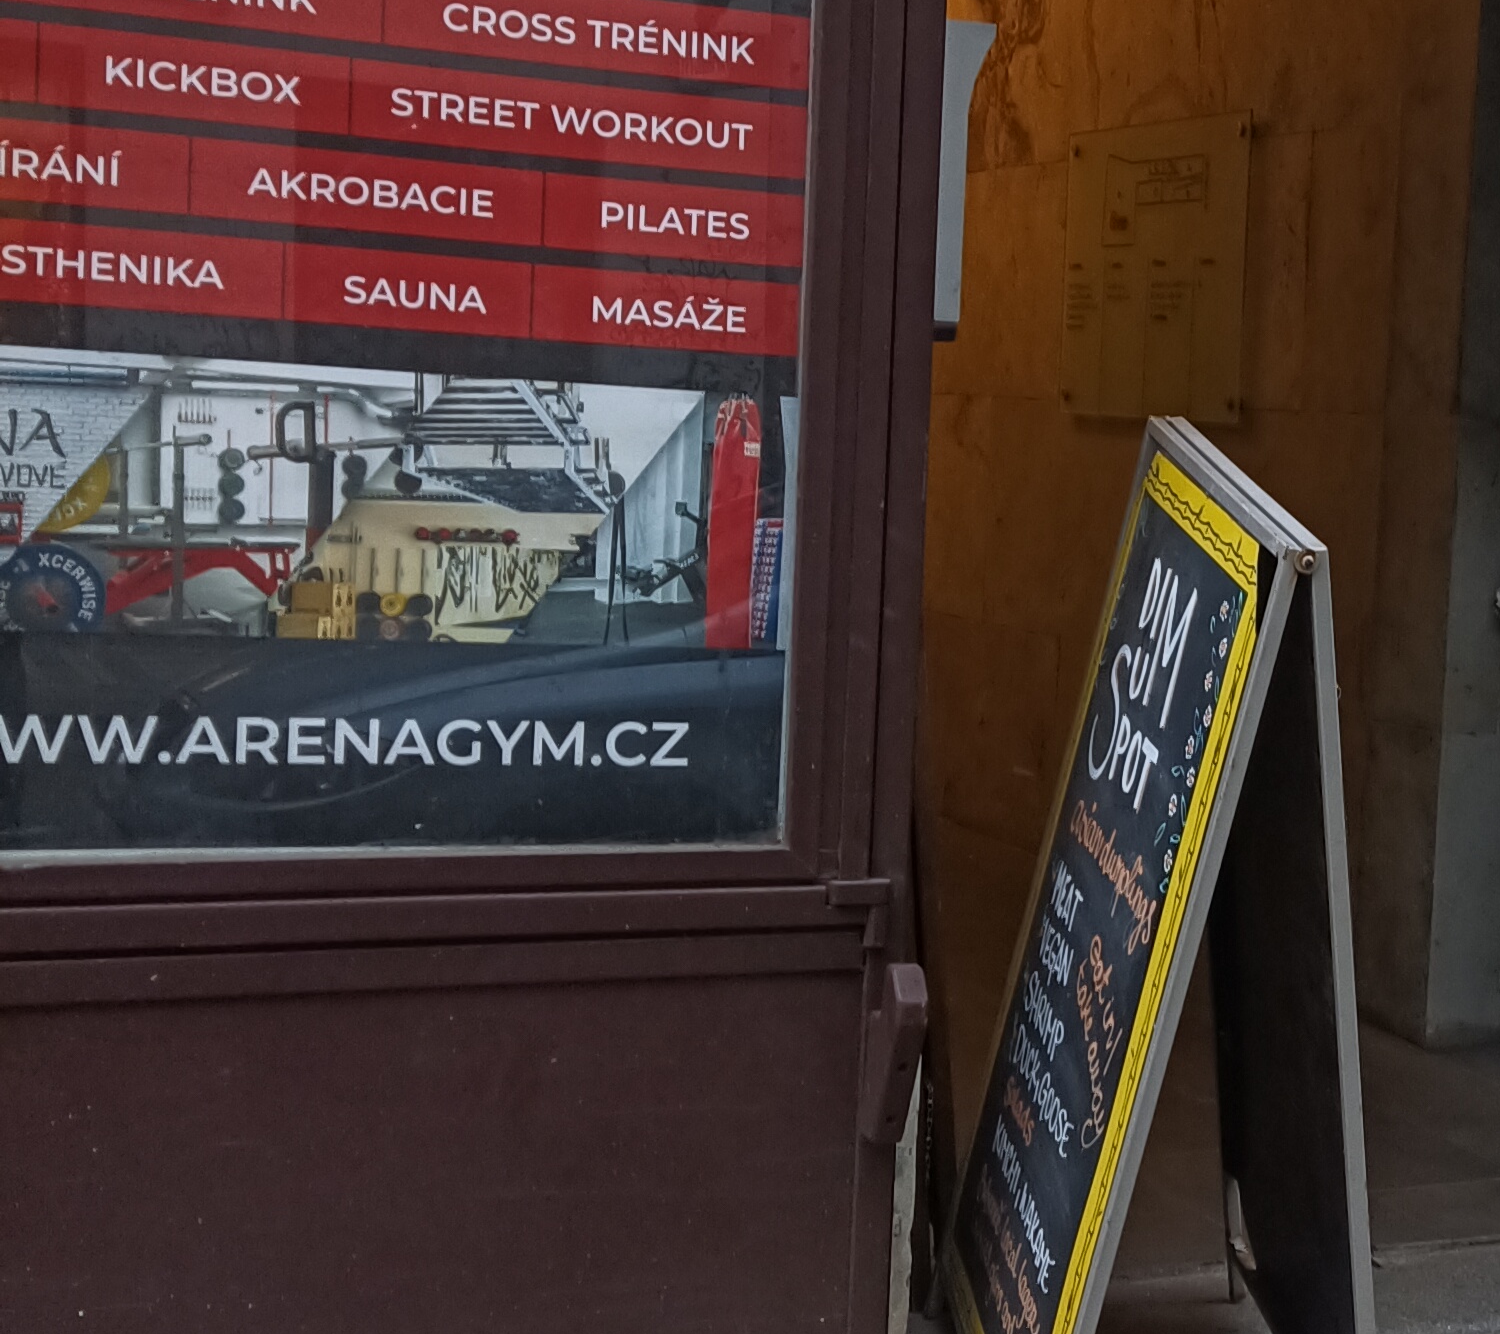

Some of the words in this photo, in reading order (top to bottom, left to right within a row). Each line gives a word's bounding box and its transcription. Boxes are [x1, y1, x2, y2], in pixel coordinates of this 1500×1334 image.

[443, 2, 576, 46] CROSS
[588, 16, 756, 66] TRÉNINK
[105, 55, 302, 107] KICKBOX
[390, 88, 540, 132] STREET
[552, 104, 754, 152] WORKOUT
[247, 167, 494, 220] AKROBACIE
[600, 201, 750, 241] PILATES
[1, 244, 225, 290] STHENIKA
[343, 275, 487, 315] SAUNA
[591, 294, 747, 334] MASÁŽE
[1050, 859, 1084, 933] MEAT
[1039, 916, 1074, 987] VEGAN
[1090, 934, 1112, 1005] eat
[1024, 970, 1064, 1062] SHRIMP
[1076, 959, 1093, 1042] take
[1081, 1041, 1105, 1149] away
